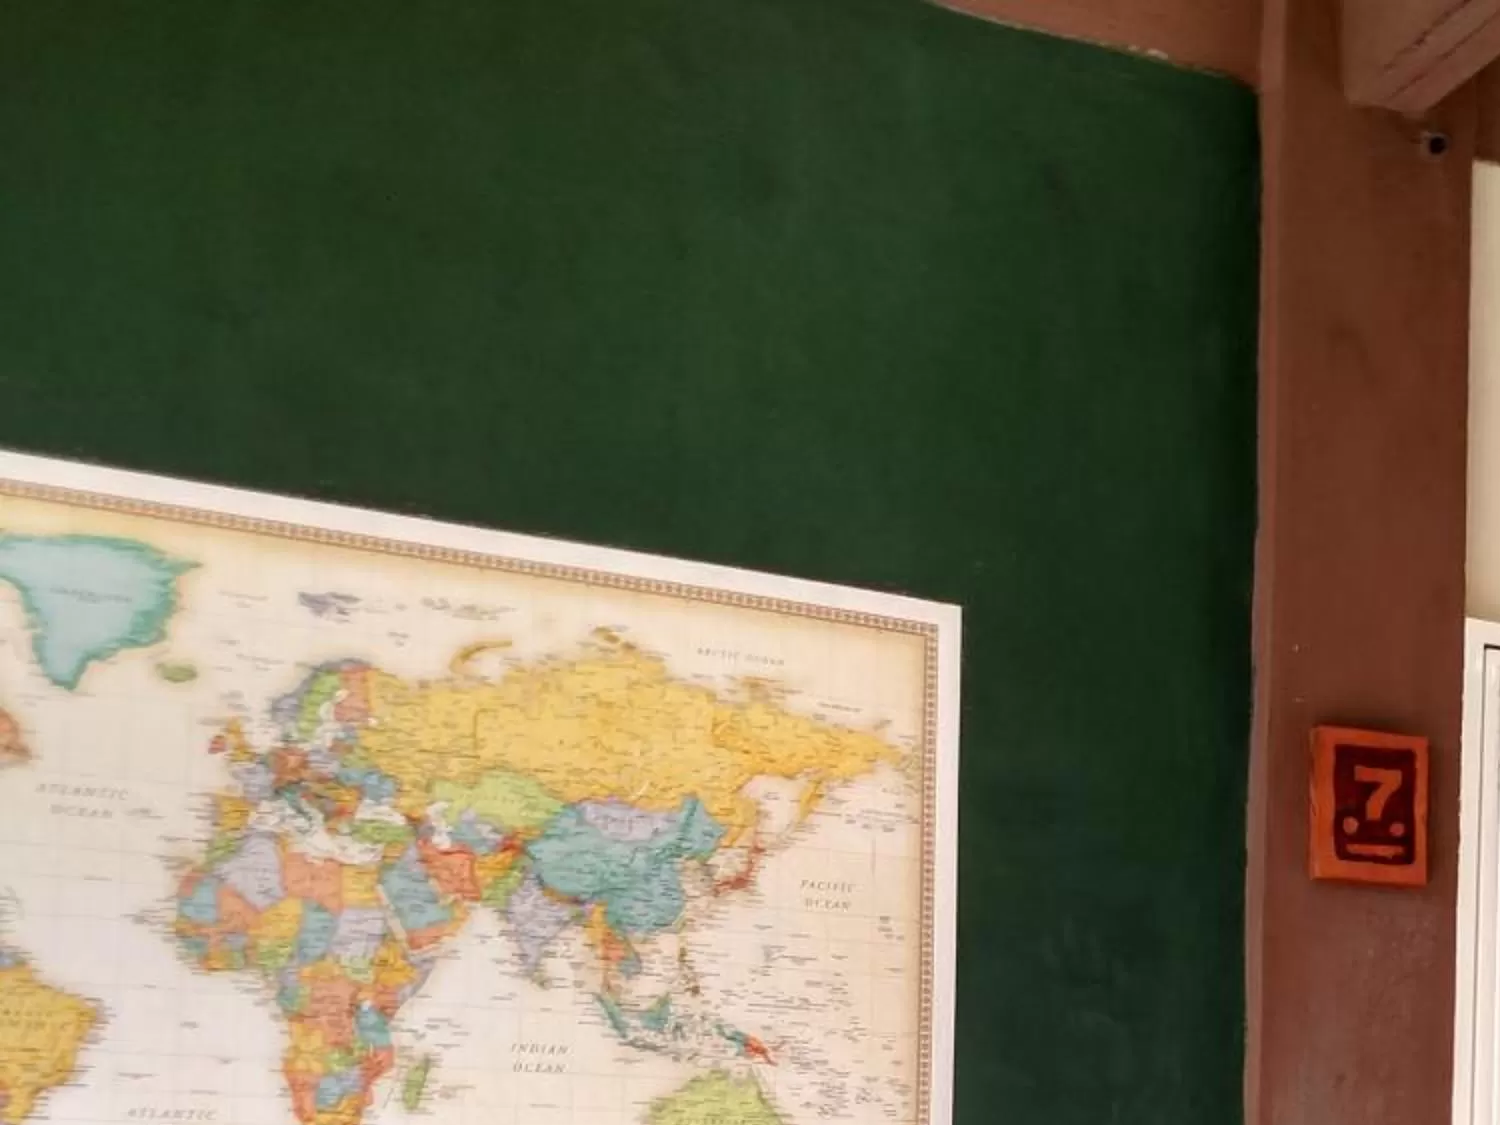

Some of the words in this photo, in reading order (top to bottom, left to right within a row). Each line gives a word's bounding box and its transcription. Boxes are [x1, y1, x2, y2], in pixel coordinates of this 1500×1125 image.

[34, 782, 129, 801] ATLANTIC
[1354, 764, 1403, 821] 7
[800, 879, 858, 893] PACIFIC
[510, 1043, 571, 1055] INDIAN
[512, 1062, 567, 1074] OCEAN
[127, 1106, 218, 1121] ATLANTIC
